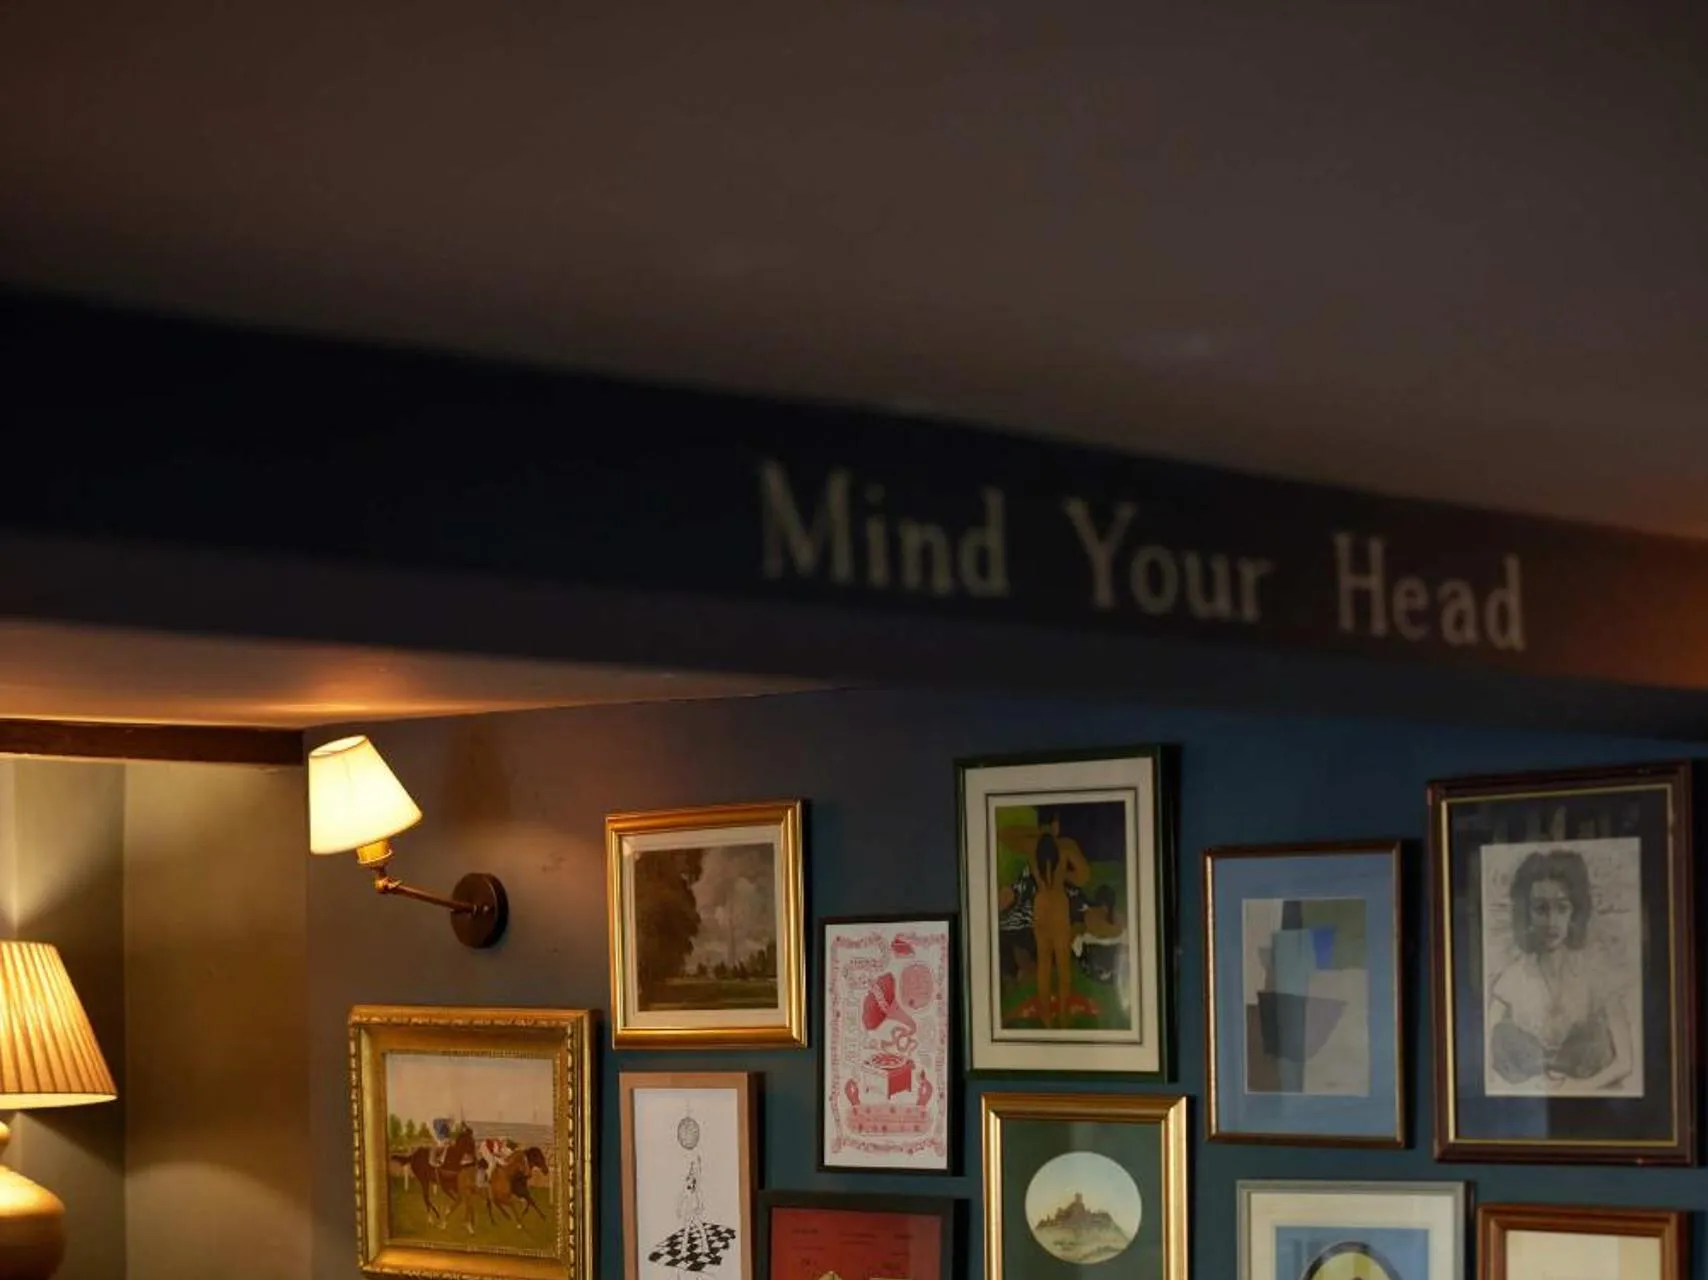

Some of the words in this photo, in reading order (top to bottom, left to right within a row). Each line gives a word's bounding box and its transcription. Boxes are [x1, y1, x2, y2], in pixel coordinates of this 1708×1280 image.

[760, 459, 1011, 598] Mind
[1062, 496, 1273, 624] Your
[1333, 531, 1527, 652] Head
